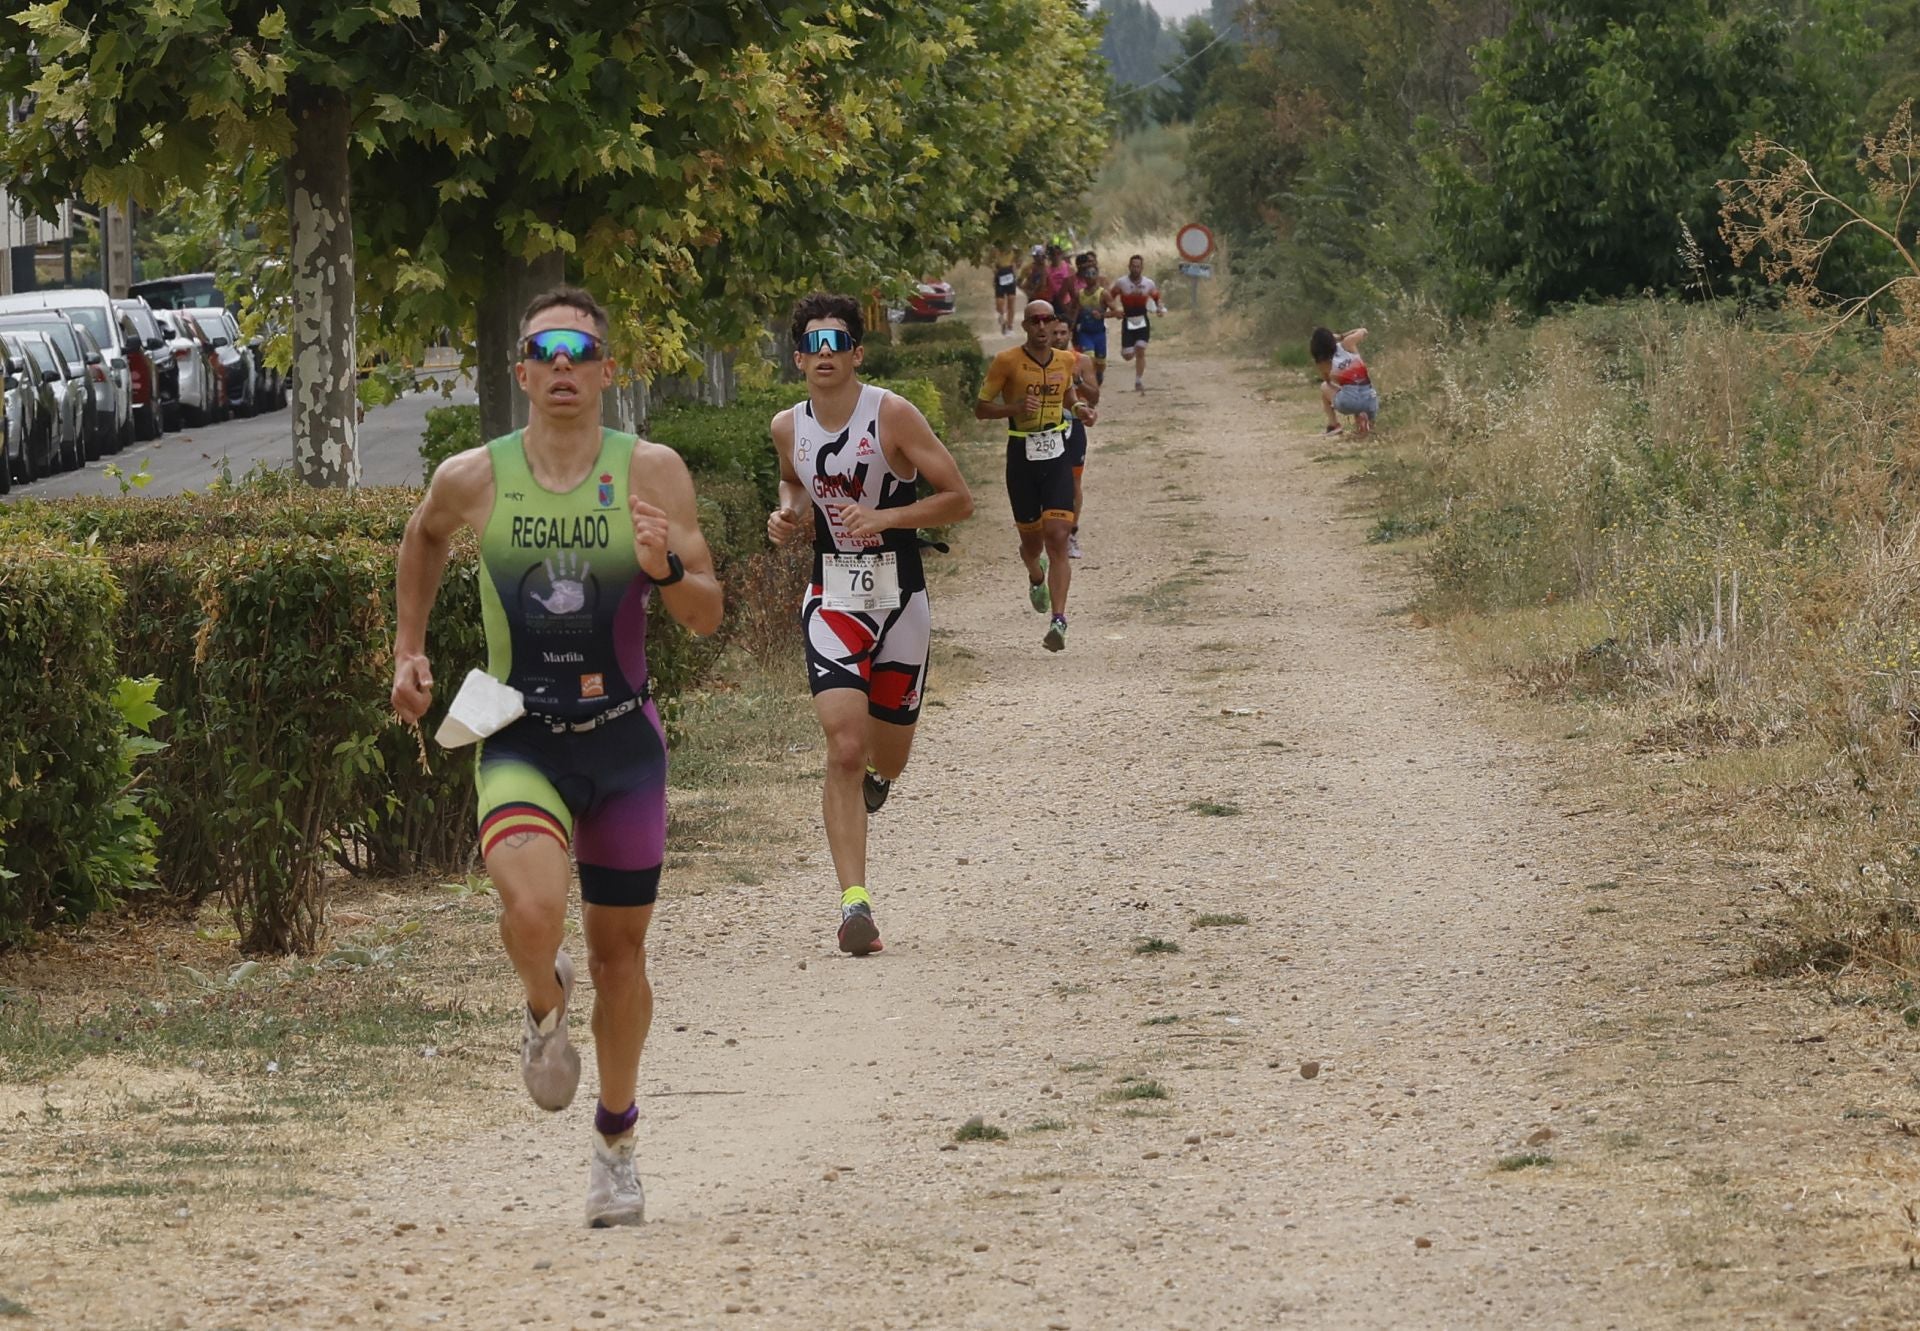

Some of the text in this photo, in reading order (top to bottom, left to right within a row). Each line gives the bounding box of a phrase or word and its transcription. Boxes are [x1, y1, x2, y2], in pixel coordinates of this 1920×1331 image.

[1035, 439, 1056, 452] 250
[511, 514, 609, 549] REGALADO
[848, 569, 875, 592] 76
